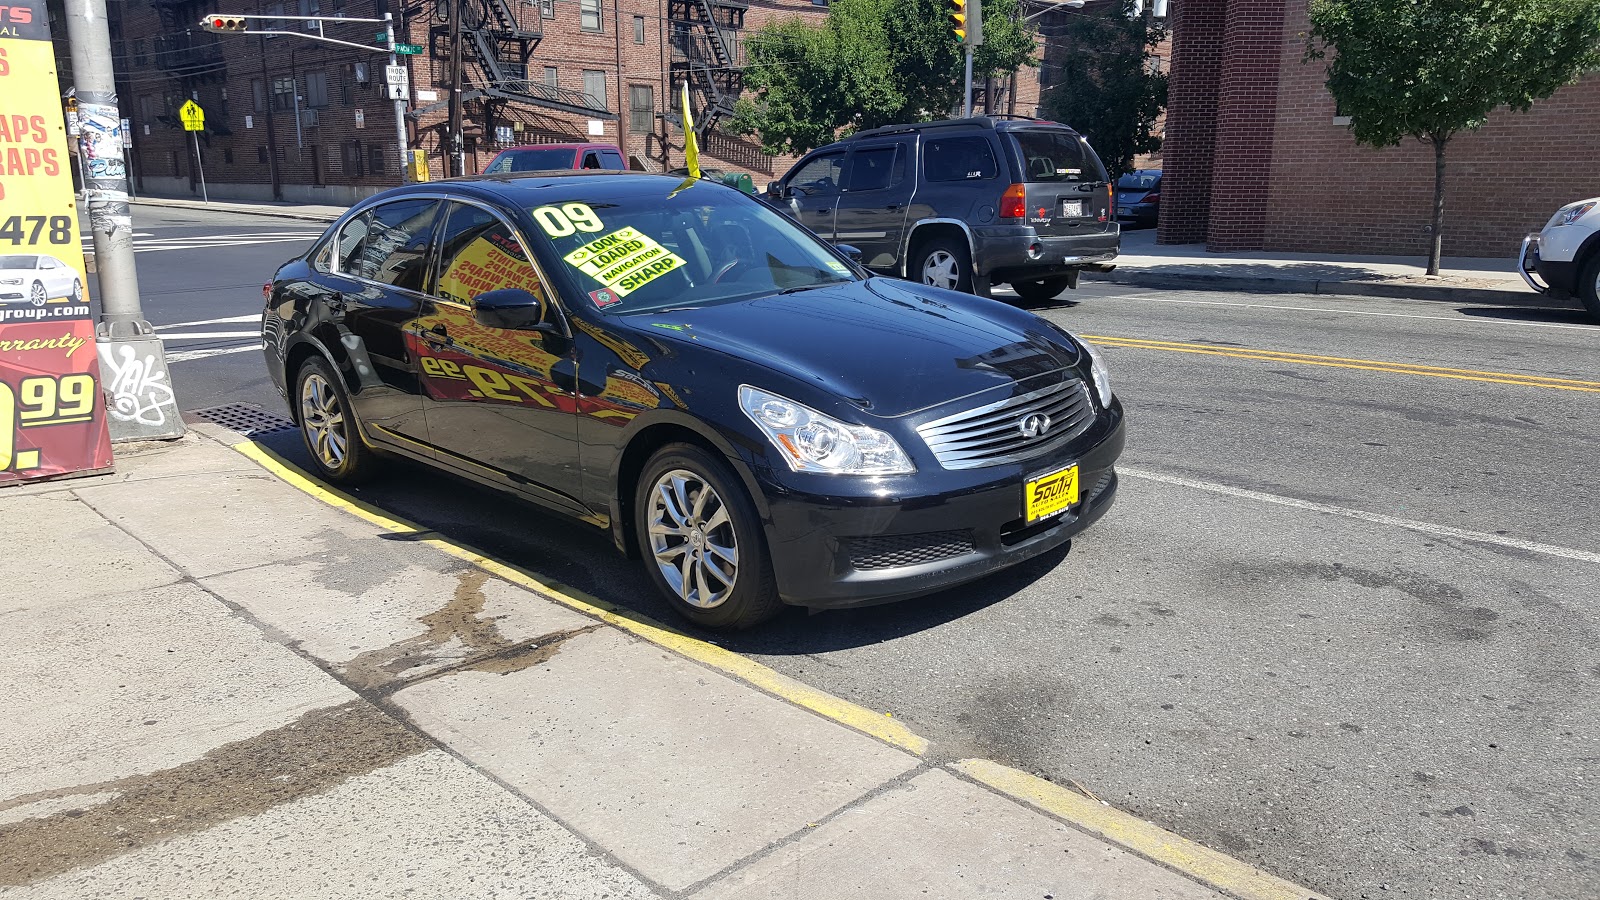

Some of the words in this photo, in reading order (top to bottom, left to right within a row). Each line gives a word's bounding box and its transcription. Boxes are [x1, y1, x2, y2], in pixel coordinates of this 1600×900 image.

[0, 26, 20, 36] AL
[0, 114, 48, 143] APS
[0, 215, 72, 246] 478
[532, 202, 605, 237] 09
[584, 234, 621, 254] LOOK
[589, 239, 644, 269] LOADED
[602, 247, 662, 281] NAVIGATION
[619, 257, 675, 290] SHARP
[1032, 476, 1073, 504] SOUTH
